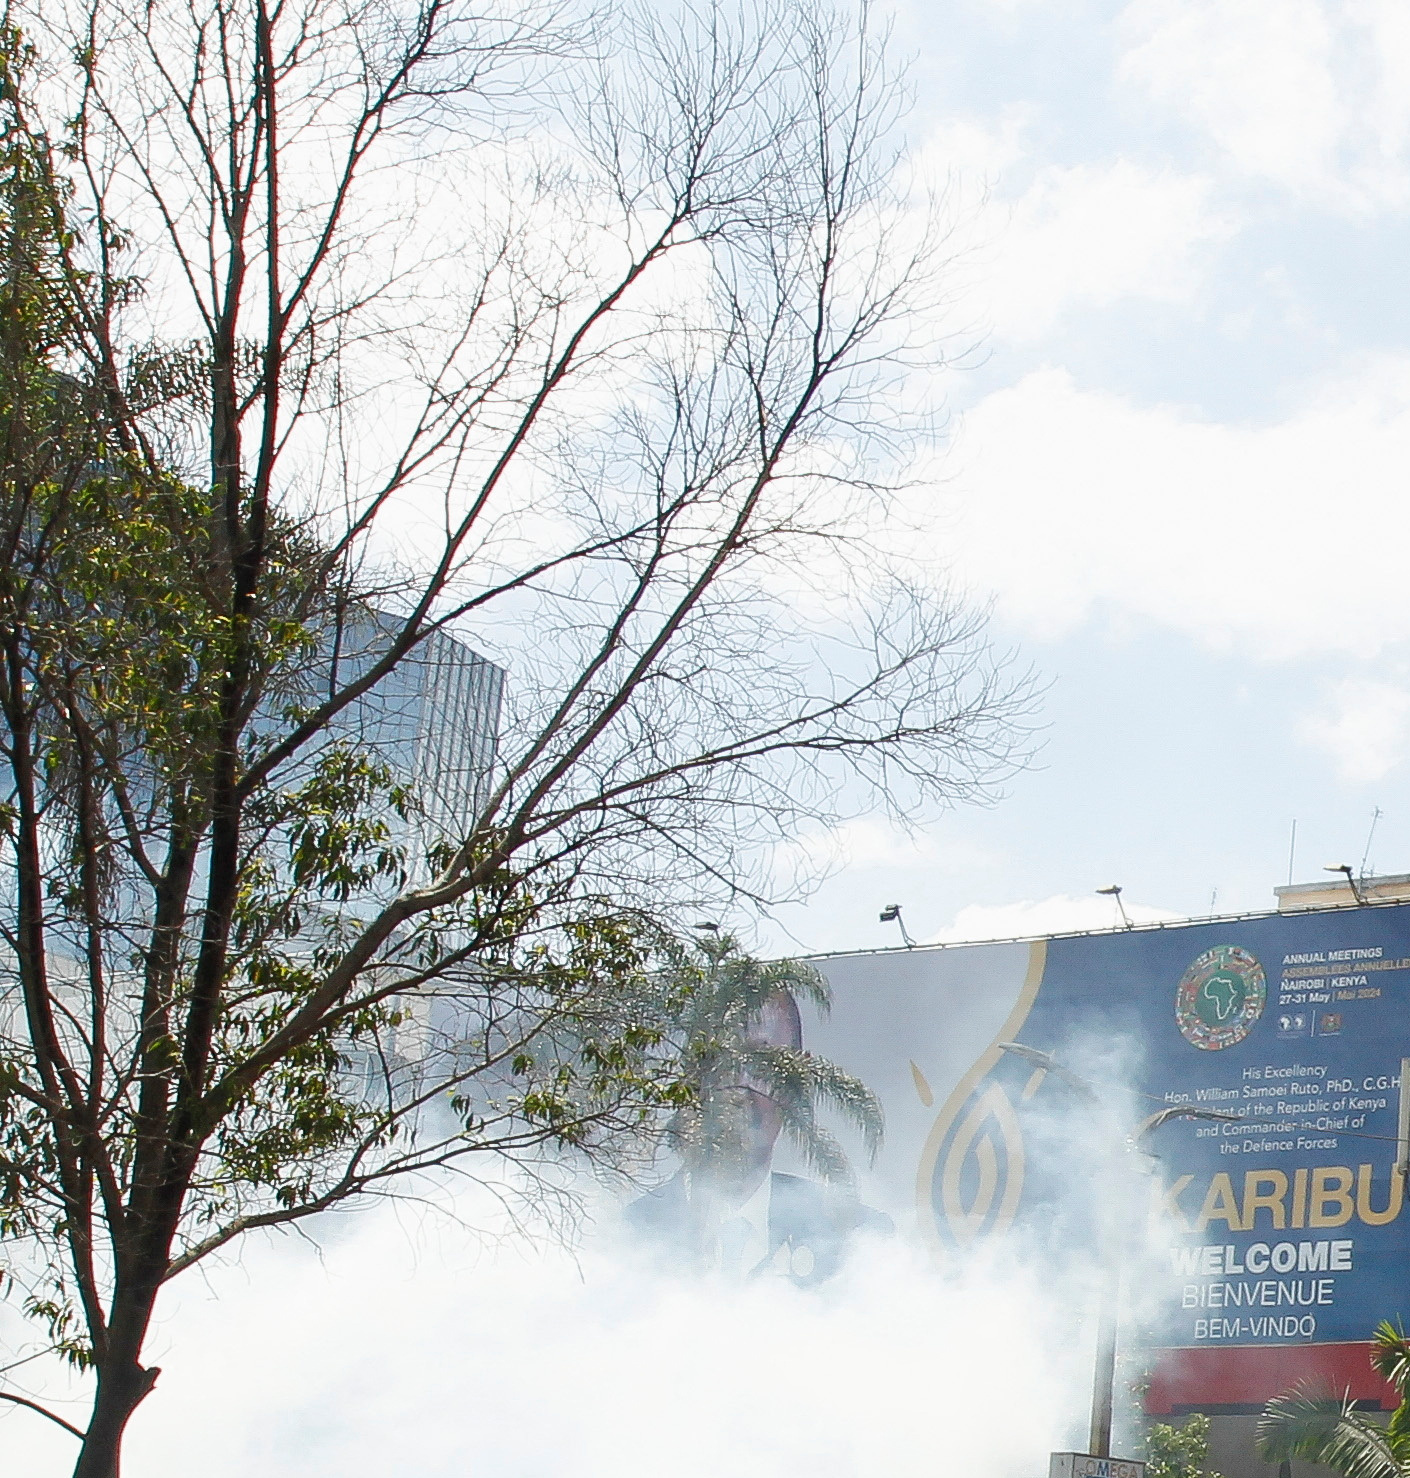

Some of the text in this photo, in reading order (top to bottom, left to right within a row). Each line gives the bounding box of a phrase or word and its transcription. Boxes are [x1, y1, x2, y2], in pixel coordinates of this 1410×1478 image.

[1282, 947, 1383, 966] ANNUAL MEETINGS
[1280, 974, 1368, 992] NAIROBI KENYA
[1279, 993, 1306, 1006] 27-31
[1309, 992, 1331, 1004] May
[1357, 987, 1382, 999] 2024
[1242, 1064, 1328, 1080] His Excellency
[1164, 1091, 1192, 1105] Hon.
[1196, 1087, 1239, 1101] William
[1242, 1083, 1288, 1098] Samoei
[1290, 1082, 1323, 1096] Ruto,
[1237, 1103, 1252, 1117] of
[1254, 1101, 1274, 1115] the
[1277, 1100, 1330, 1116] Republic
[1332, 1099, 1348, 1112] of
[1349, 1096, 1386, 1111] Kenya
[1196, 1124, 1219, 1138] and
[1352, 1113, 1366, 1128] of
[1220, 1137, 1338, 1155] the Defence Forces
[1150, 1163, 1405, 1234] KARIBU
[1170, 1239, 1354, 1277] WELCOME
[1181, 1279, 1336, 1309] BIENVENUE
[1194, 1314, 1317, 1339] BEM-VINDO
[1086, 1460, 1138, 1478] OMEGA
